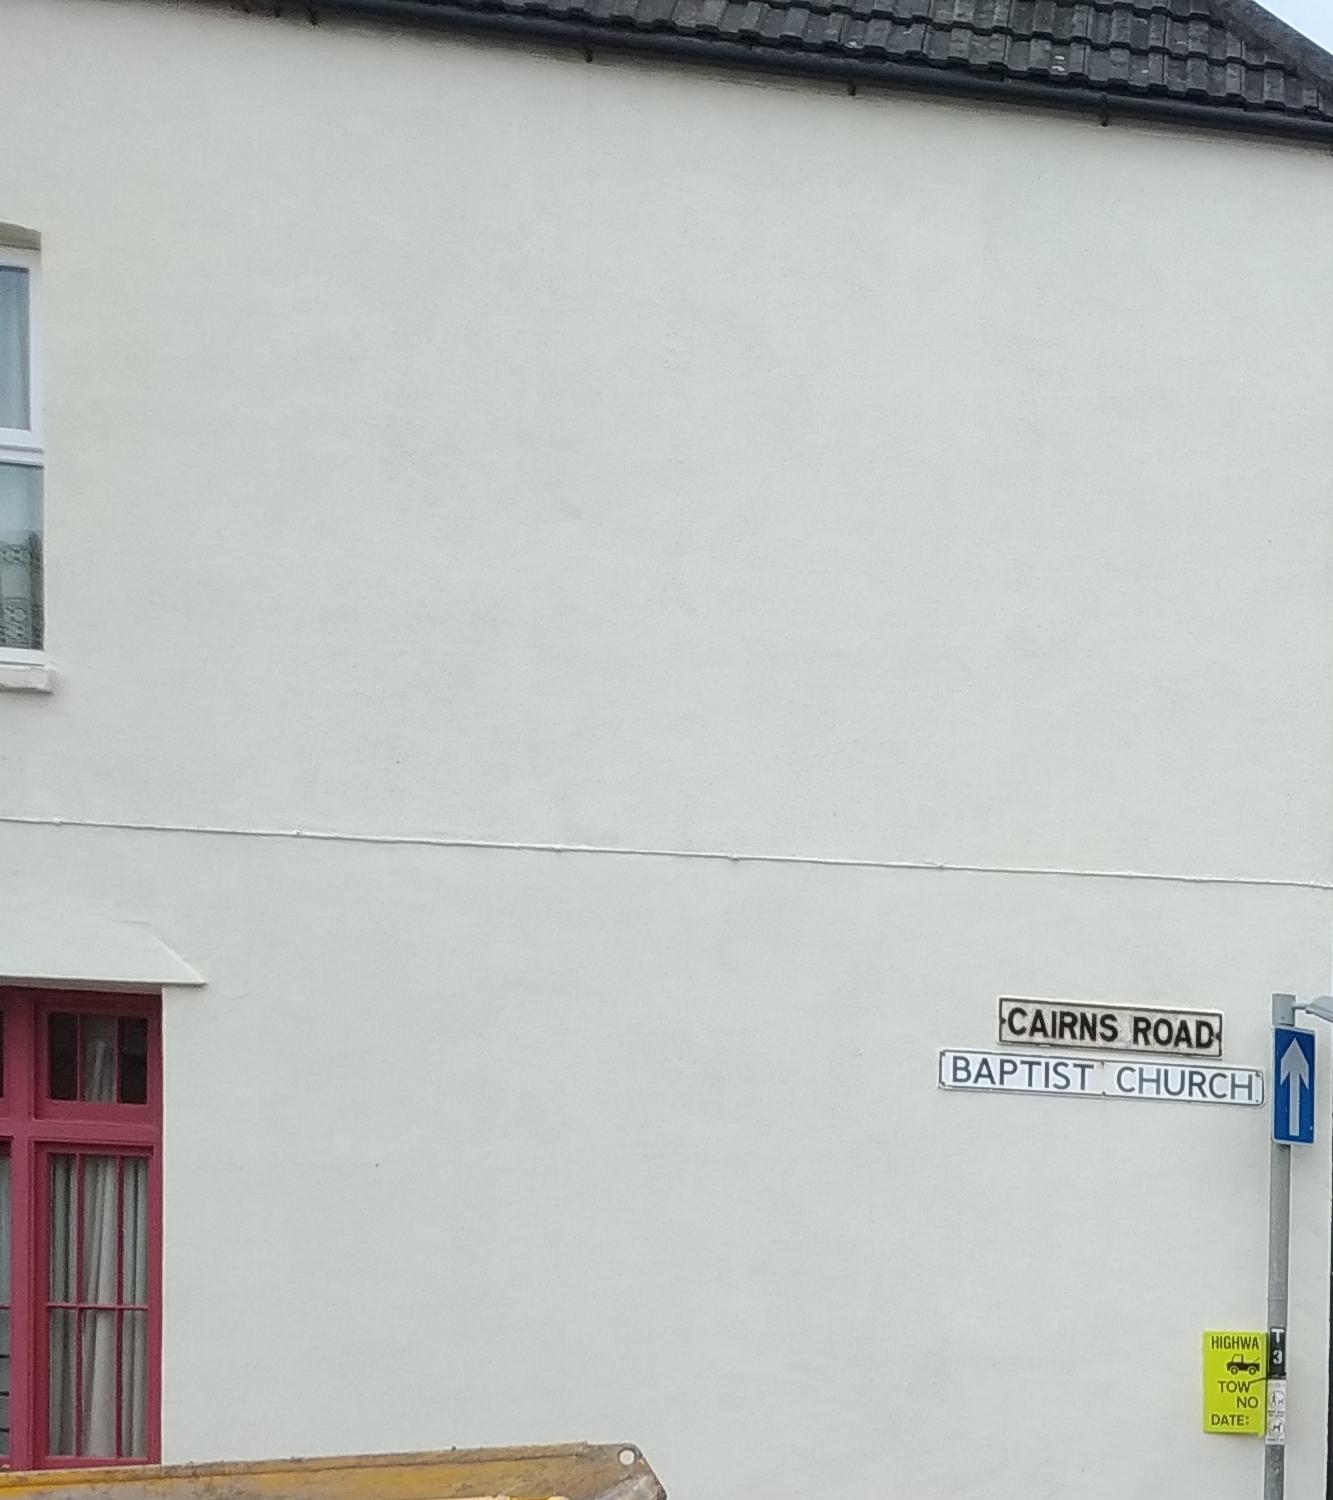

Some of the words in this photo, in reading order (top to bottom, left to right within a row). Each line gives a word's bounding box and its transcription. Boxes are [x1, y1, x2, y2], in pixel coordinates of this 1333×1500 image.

[1007, 1007, 1119, 1042] CAIRNS
[1133, 1016, 1214, 1049] ROAD
[952, 1055, 1095, 1091] BAPTIST
[1116, 1066, 1254, 1101] CHURCH
[1211, 1335, 1260, 1351] HIGHWA
[1271, 1328, 1285, 1344] T
[1273, 1349, 1283, 1365] 3
[1218, 1380, 1251, 1393] TOW
[1236, 1396, 1259, 1409] NO
[1211, 1414, 1250, 1426] DATE:
